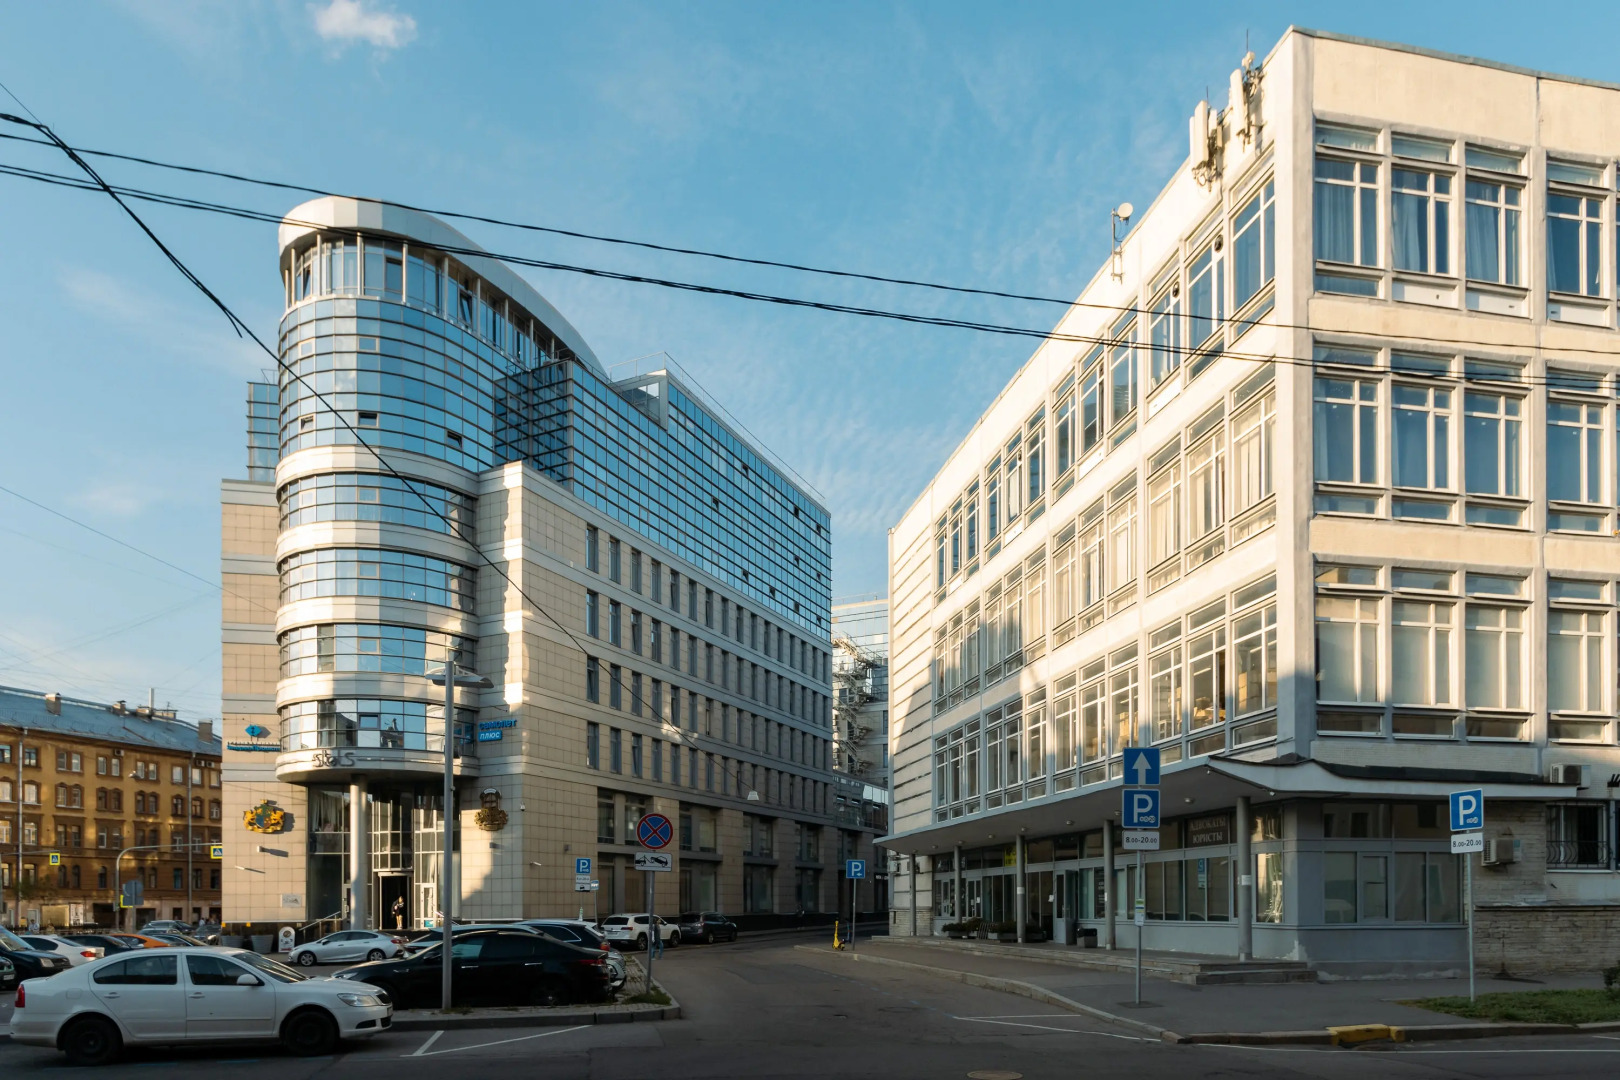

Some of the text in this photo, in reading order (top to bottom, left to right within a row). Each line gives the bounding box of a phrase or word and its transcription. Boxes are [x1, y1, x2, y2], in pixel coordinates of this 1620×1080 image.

[1133, 794, 1153, 823] P
[1459, 795, 1477, 826] P
[1125, 836, 1158, 844] 8.00-20.00
[1192, 832, 1223, 844] ЮРИСТЫ
[1452, 839, 1482, 848] 8.00-20.00
[580, 860, 589, 872] P
[851, 861, 862, 877] P
